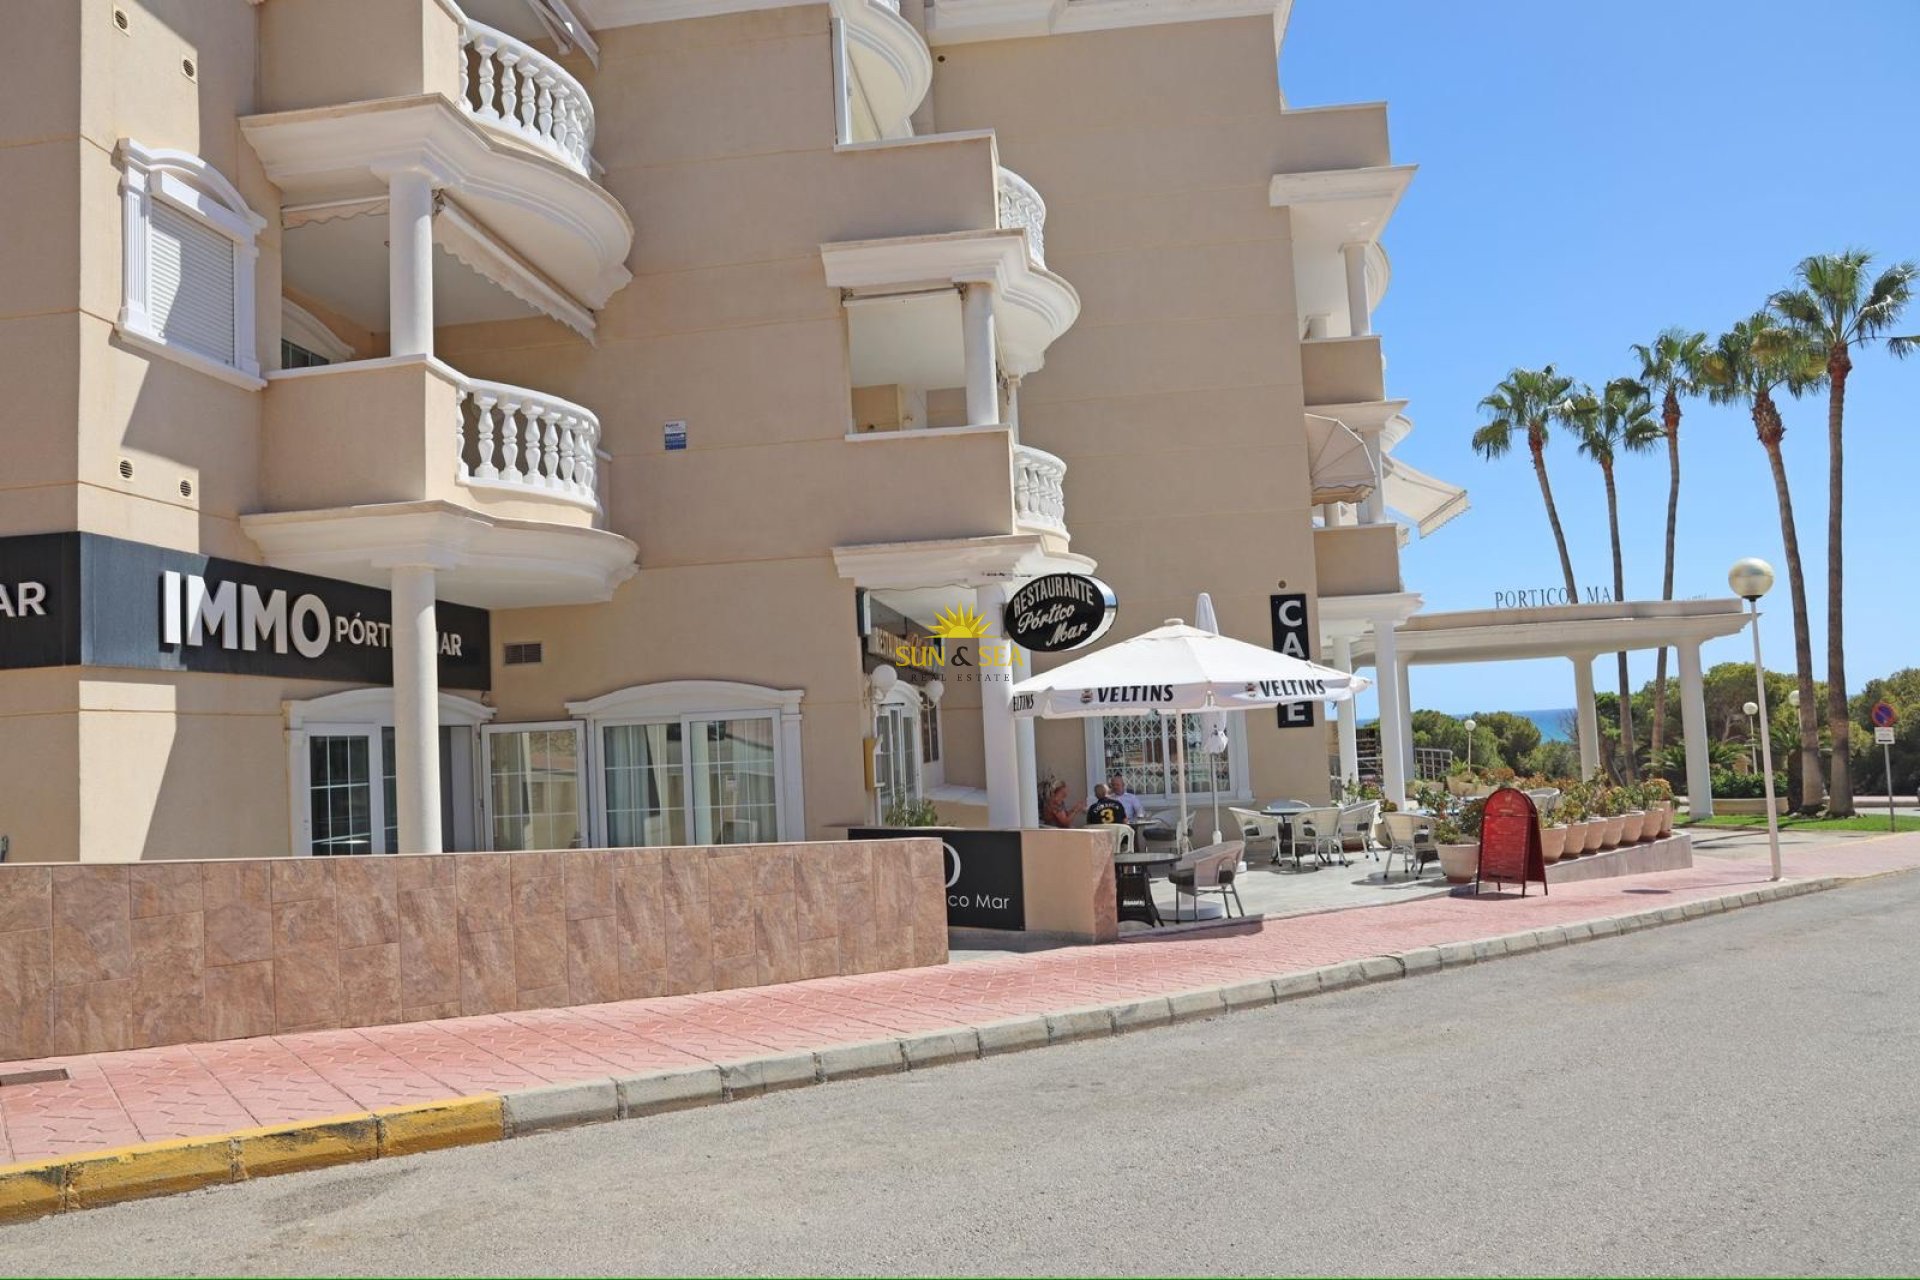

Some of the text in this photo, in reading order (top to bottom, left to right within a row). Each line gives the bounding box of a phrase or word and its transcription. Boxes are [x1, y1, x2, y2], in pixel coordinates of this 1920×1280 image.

[1013, 576, 1095, 618] RESTAURANTE
[1586, 586, 1612, 605] MA
[163, 570, 462, 659] IMMO PÓRT AR
[1017, 603, 1075, 634] Pórtico
[1045, 621, 1088, 647] Mar
[1278, 600, 1306, 721] CAE
[1097, 684, 1174, 703] VELTINS
[1260, 679, 1326, 697] VELTINS
[1013, 694, 1035, 712] ELTINS
[1100, 808, 1115, 823] 3
[976, 894, 1010, 909] Mar
